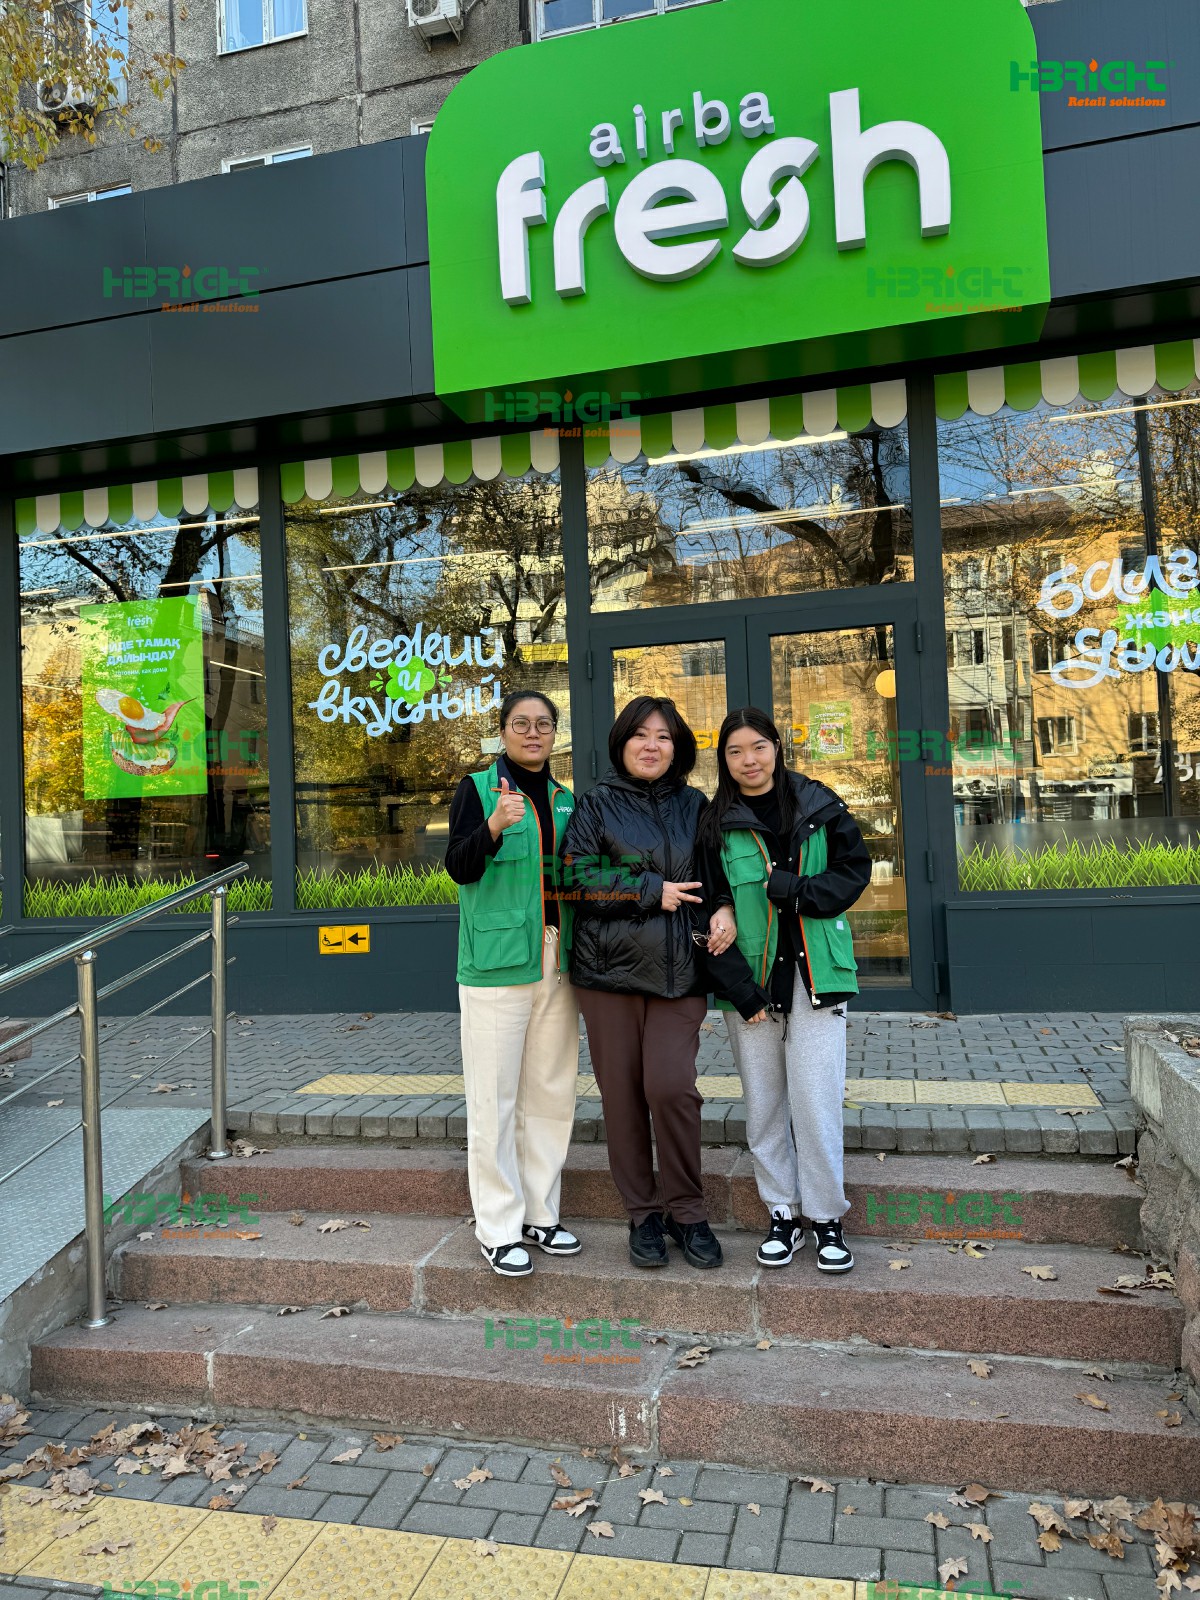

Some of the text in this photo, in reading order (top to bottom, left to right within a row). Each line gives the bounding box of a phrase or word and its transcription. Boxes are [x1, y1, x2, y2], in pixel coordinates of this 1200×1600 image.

[588, 91, 775, 167] airba
[496, 87, 952, 307] fresh
[127, 614, 153, 627] fresh
[136, 637, 181, 649] ТАМАҚ
[318, 622, 504, 677] свежий
[106, 650, 176, 666] ДАЙЫНДАУ
[153, 666, 168, 675] дома
[397, 669, 422, 692] и
[308, 673, 502, 738] вкусный
